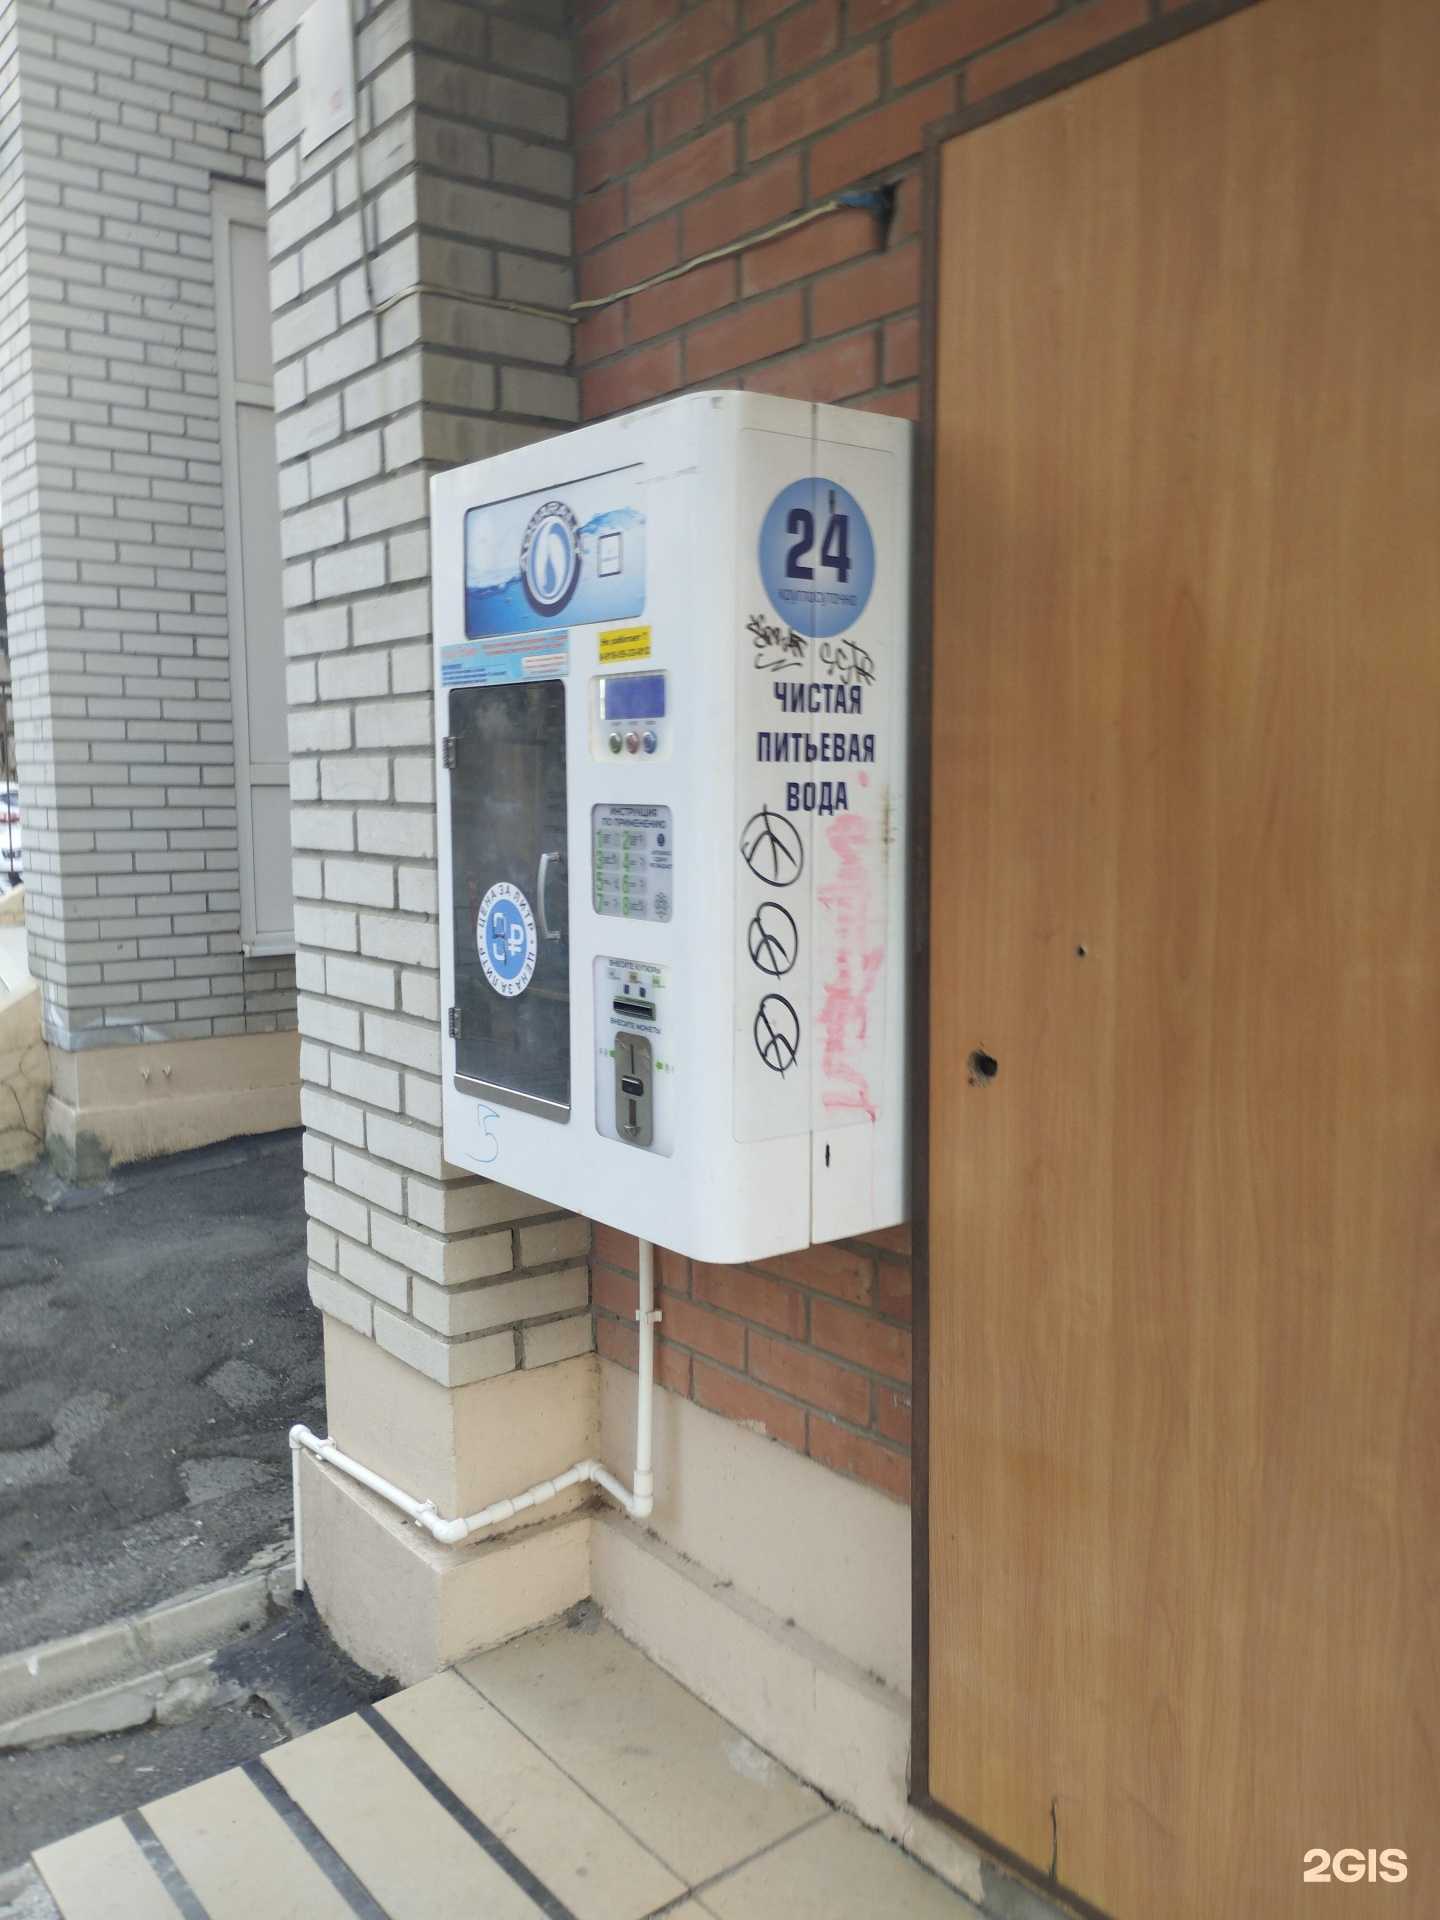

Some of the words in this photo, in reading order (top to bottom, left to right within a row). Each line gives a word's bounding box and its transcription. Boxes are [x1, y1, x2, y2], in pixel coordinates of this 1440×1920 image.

[786, 508, 852, 583] 24
[774, 682, 862, 714] ЧИСТАЯ
[758, 732, 875, 762] ПИТЬЕВАЯ
[786, 782, 848, 816] ВОДА
